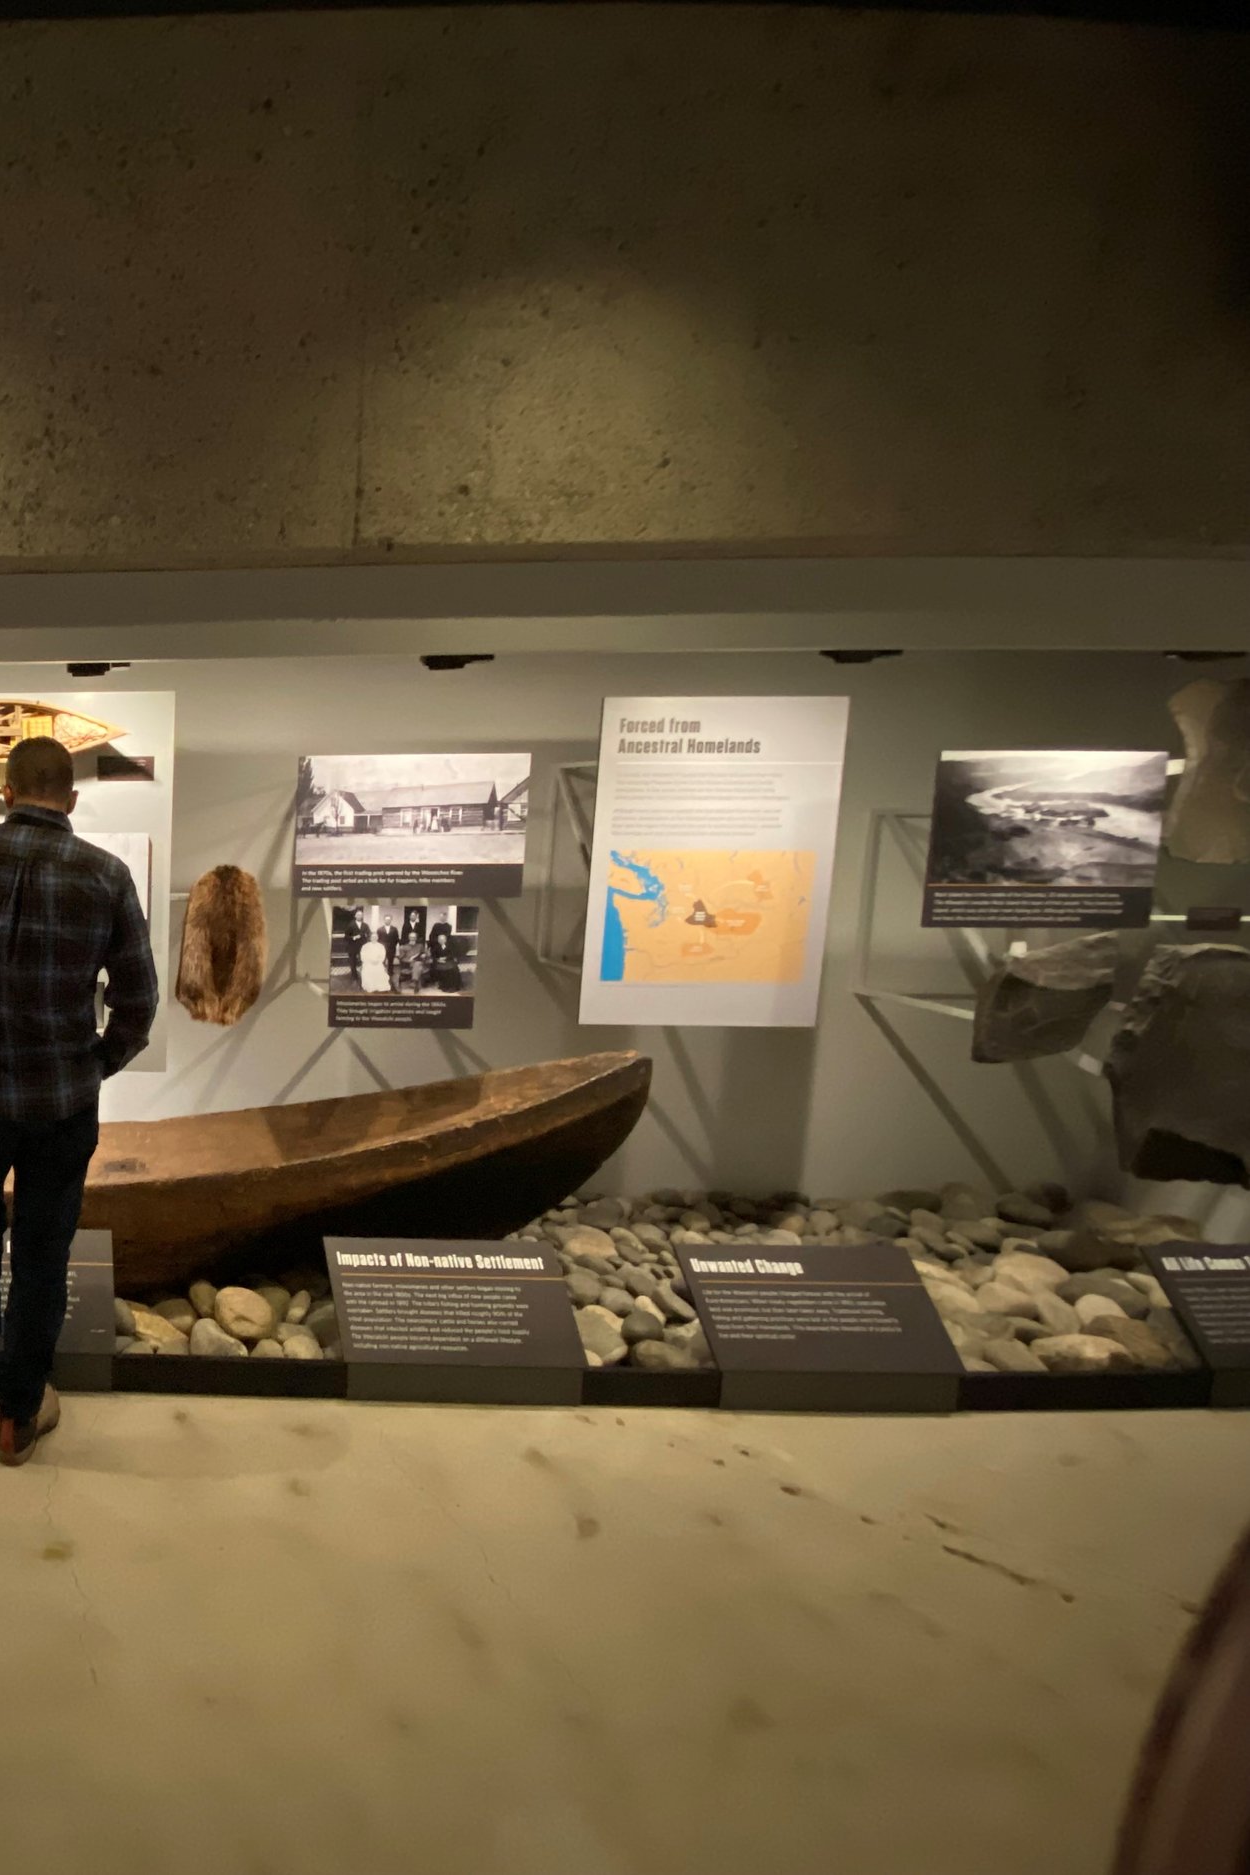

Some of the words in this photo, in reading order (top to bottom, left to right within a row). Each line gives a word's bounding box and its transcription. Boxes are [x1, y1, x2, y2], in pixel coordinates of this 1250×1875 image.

[619, 718, 665, 733] Forced
[669, 717, 701, 733] from
[617, 738, 683, 754] Ancestral
[687, 738, 761, 754] Homelands
[336, 1251, 387, 1267] Impacts
[389, 1252, 402, 1267] of
[405, 1253, 473, 1269] Non-native
[475, 1254, 544, 1270] Settlement
[690, 1258, 755, 1273] Unwanted
[754, 1259, 804, 1276] Change
